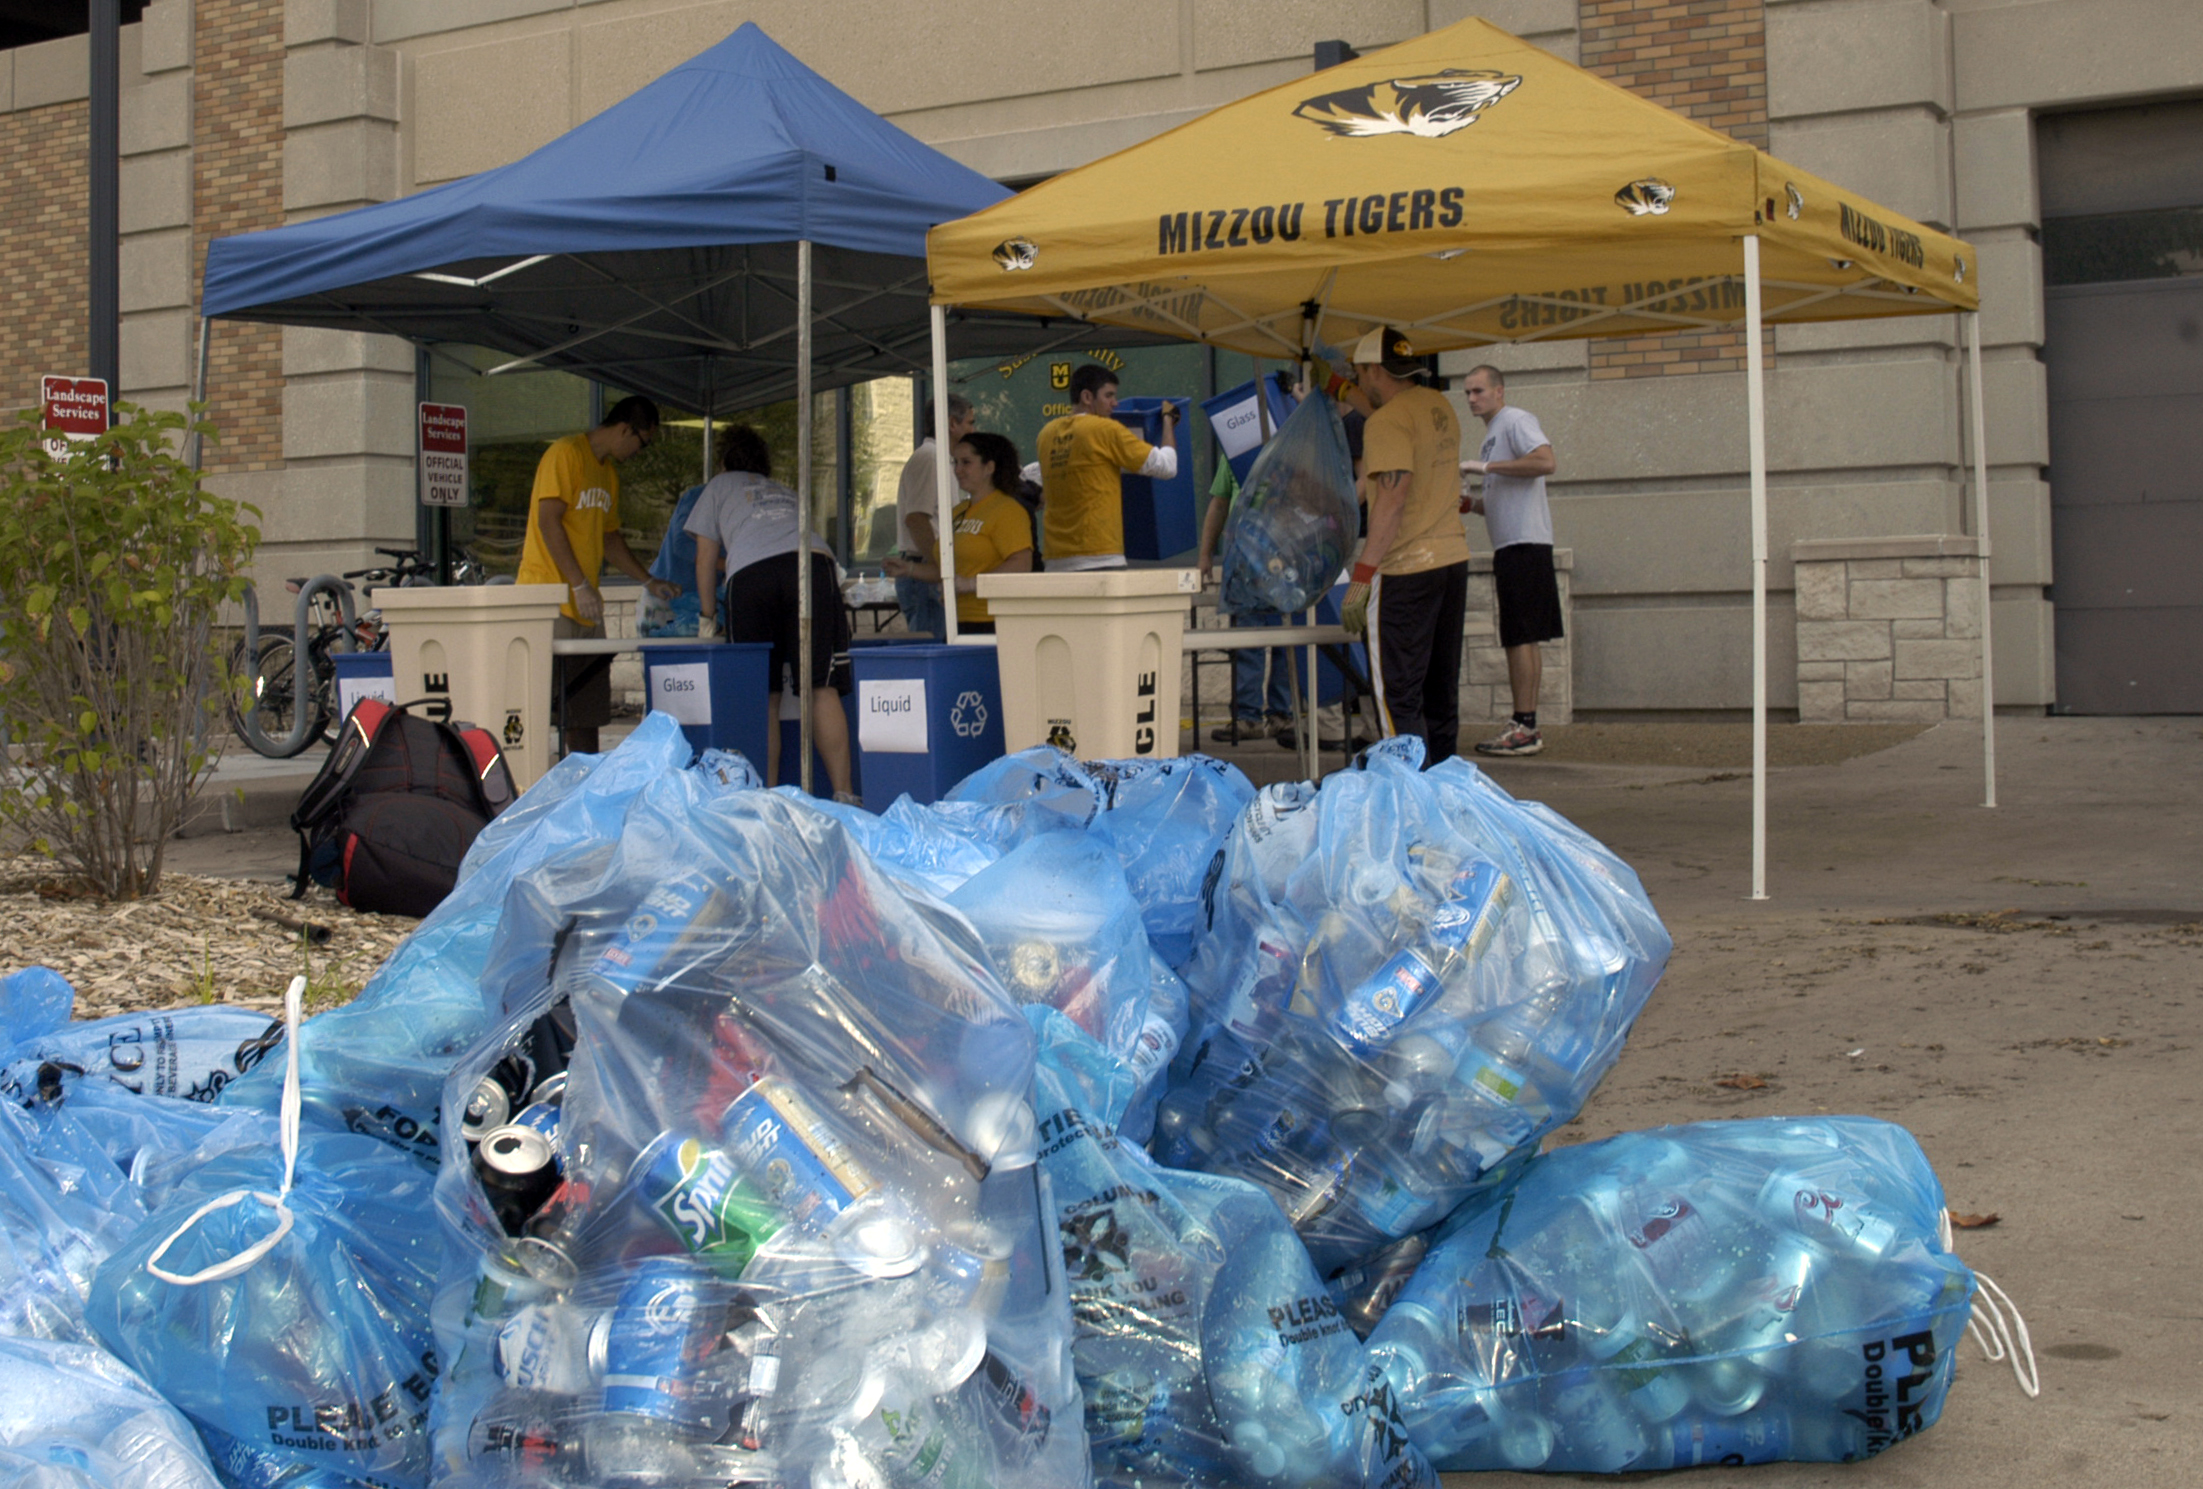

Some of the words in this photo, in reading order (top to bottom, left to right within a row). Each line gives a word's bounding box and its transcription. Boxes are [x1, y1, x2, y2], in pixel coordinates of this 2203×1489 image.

[1158, 202, 1304, 256] MIZZOU
[1323, 186, 1465, 239] TIGERS
[1839, 201, 1886, 254] MIZZOU
[1885, 224, 1924, 269] TIGERS
[46, 386, 107, 407] Landscape
[52, 403, 100, 420] Services
[422, 411, 466, 429] Landscape
[1226, 410, 1256, 430] Glass
[427, 426, 461, 440] Services
[425, 456, 463, 470] OFFICIAL
[427, 472, 463, 485] VEHICLE
[430, 486, 460, 500] ONLY
[663, 677, 695, 693] Glass
[870, 694, 912, 717] Liquid
[1135, 670, 1156, 755] CLE
[1118, 1276, 1159, 1295] YOU
[1266, 1295, 1338, 1332] PLEAS
[1862, 1339, 1890, 1429] Double
[271, 1432, 337, 1451] Double
